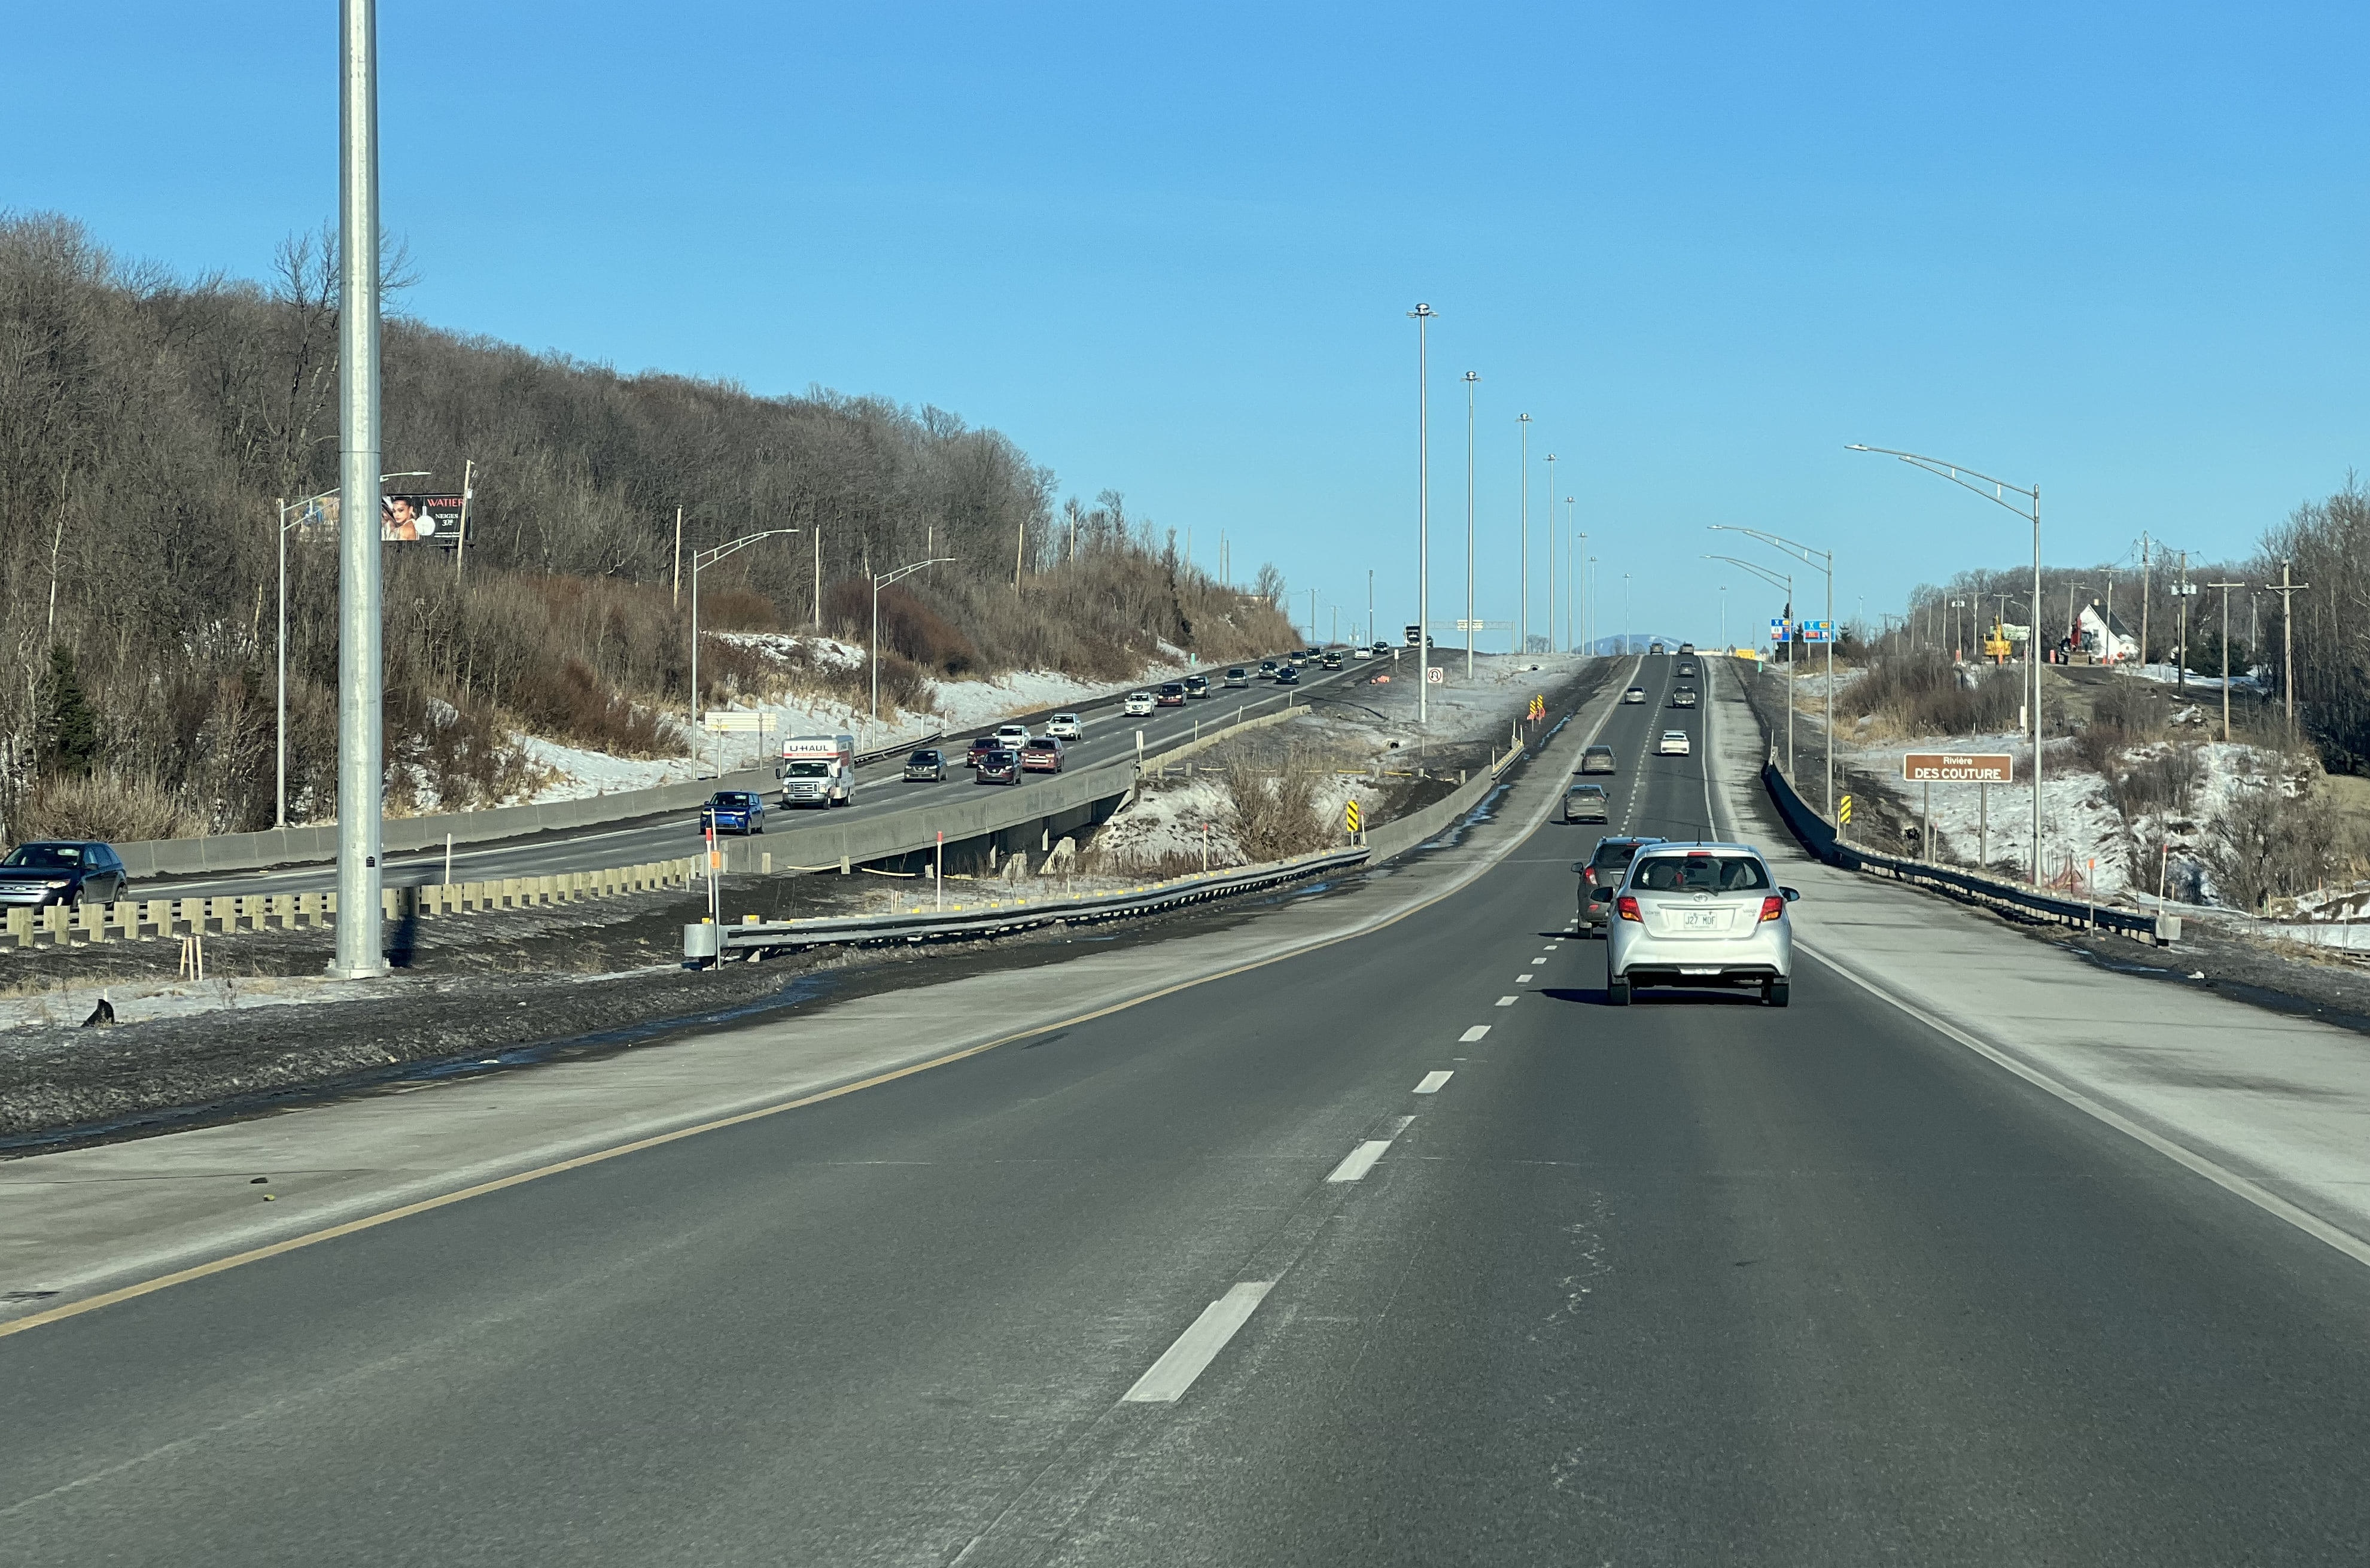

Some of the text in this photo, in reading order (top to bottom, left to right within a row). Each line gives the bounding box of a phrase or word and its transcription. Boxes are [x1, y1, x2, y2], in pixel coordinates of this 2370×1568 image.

[1943, 756, 1973, 765] Rivière
[1915, 768, 2001, 780] DES COUTURE
[1685, 916, 1698, 925] J27
